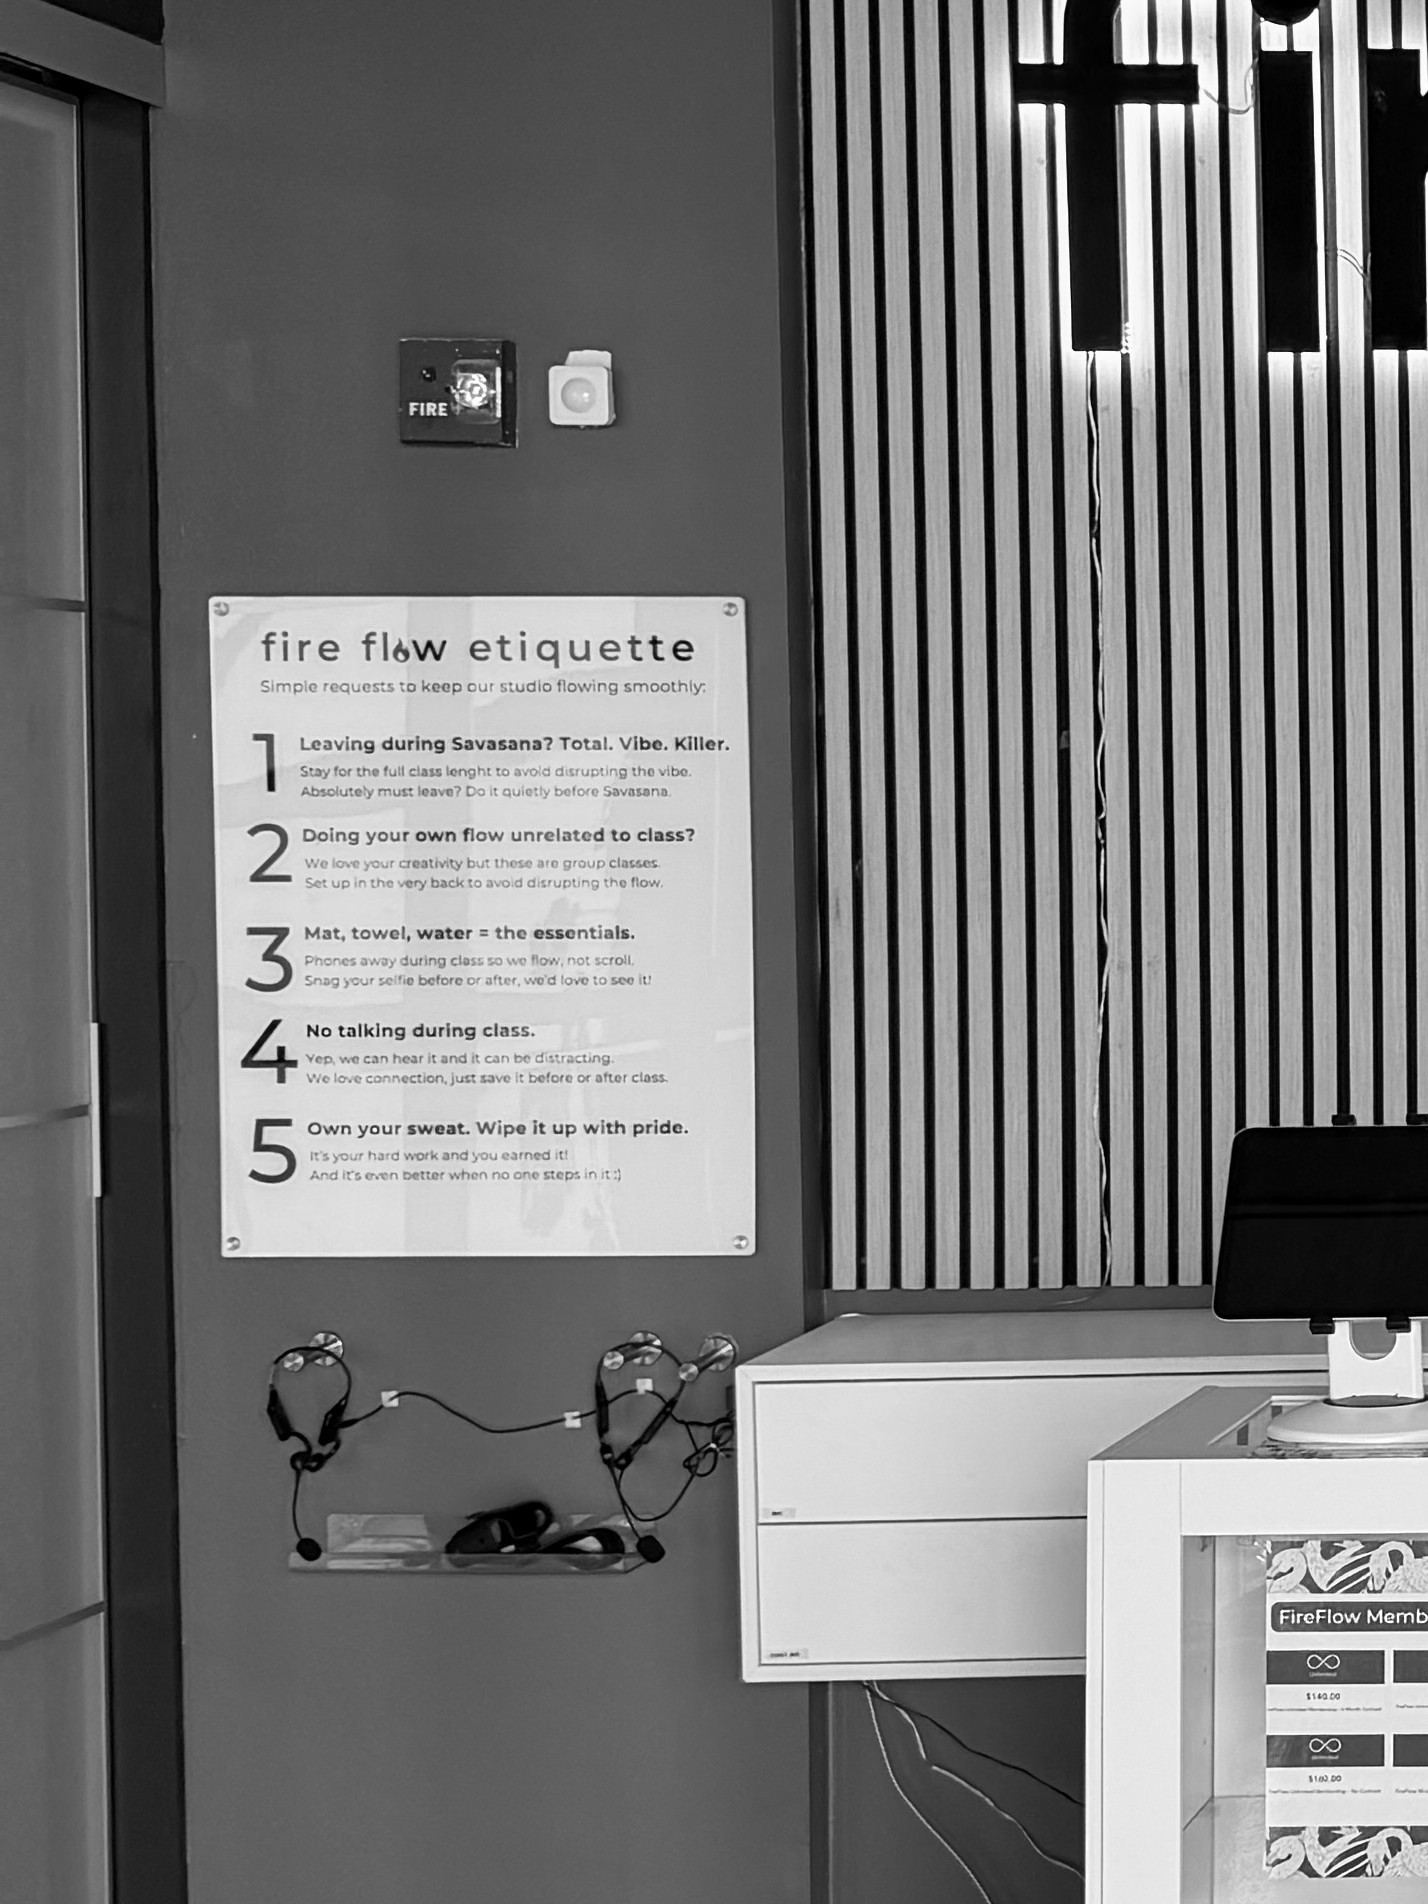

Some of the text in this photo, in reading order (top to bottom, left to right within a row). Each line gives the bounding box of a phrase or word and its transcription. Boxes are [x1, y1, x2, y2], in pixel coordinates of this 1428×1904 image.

[408, 402, 448, 416] FIRE
[261, 631, 340, 661] fire
[469, 631, 694, 669] etiquette
[261, 679, 706, 696] Simple requests to keep our studio flowing smoothly:
[300, 736, 729, 754] Leaving during Savasana? Total. Vibe. Killer.
[252, 733, 276, 792] 1
[300, 765, 330, 779] Stay
[333, 766, 353, 777] for
[356, 766, 380, 777] the
[383, 765, 405, 777] full
[409, 765, 442, 777] class
[446, 765, 492, 780] lenght
[514, 765, 550, 777] avoid
[555, 766, 627, 780] disrupting
[632, 765, 655, 777] the
[658, 765, 691, 777] vibe.
[301, 785, 374, 800] Absolutely
[378, 787, 414, 797] must
[418, 785, 461, 797] leave?
[466, 785, 485, 797] Do
[502, 785, 550, 799] quietly
[554, 785, 599, 797] before
[603, 786, 671, 797] Savasana.
[303, 827, 695, 845] Doing your own flow unrelated to class?
[247, 823, 292, 882] 2
[305, 875, 663, 892] Set up in the very back to avoid disrupting the flow.
[305, 925, 634, 942] Mat, towel, water = the essentials.
[245, 927, 293, 992] 3
[304, 975, 340, 989] Snag
[343, 977, 374, 989] your
[379, 975, 414, 986] selfie
[418, 974, 463, 986] before
[467, 977, 481, 985] or
[485, 974, 520, 987] after,
[524, 974, 556, 986] we'd
[561, 974, 589, 986] love
[611, 976, 634, 986] see
[639, 973, 651, 985] it!
[307, 1023, 535, 1041] No talking during class.
[241, 1019, 298, 1084] 4
[306, 1073, 330, 1084] We
[334, 1073, 362, 1084] love
[365, 1072, 447, 1085] connection,
[450, 1072, 476, 1086] just
[480, 1075, 511, 1084] save
[528, 1072, 573, 1083] before
[577, 1074, 591, 1083] or
[595, 1071, 628, 1083] after
[631, 1072, 668, 1083] class.
[308, 1119, 688, 1139] Own your sweat. Wipe it up with pride.
[248, 1118, 297, 1184] 5
[1279, 1608, 1361, 1625] FireFlow
